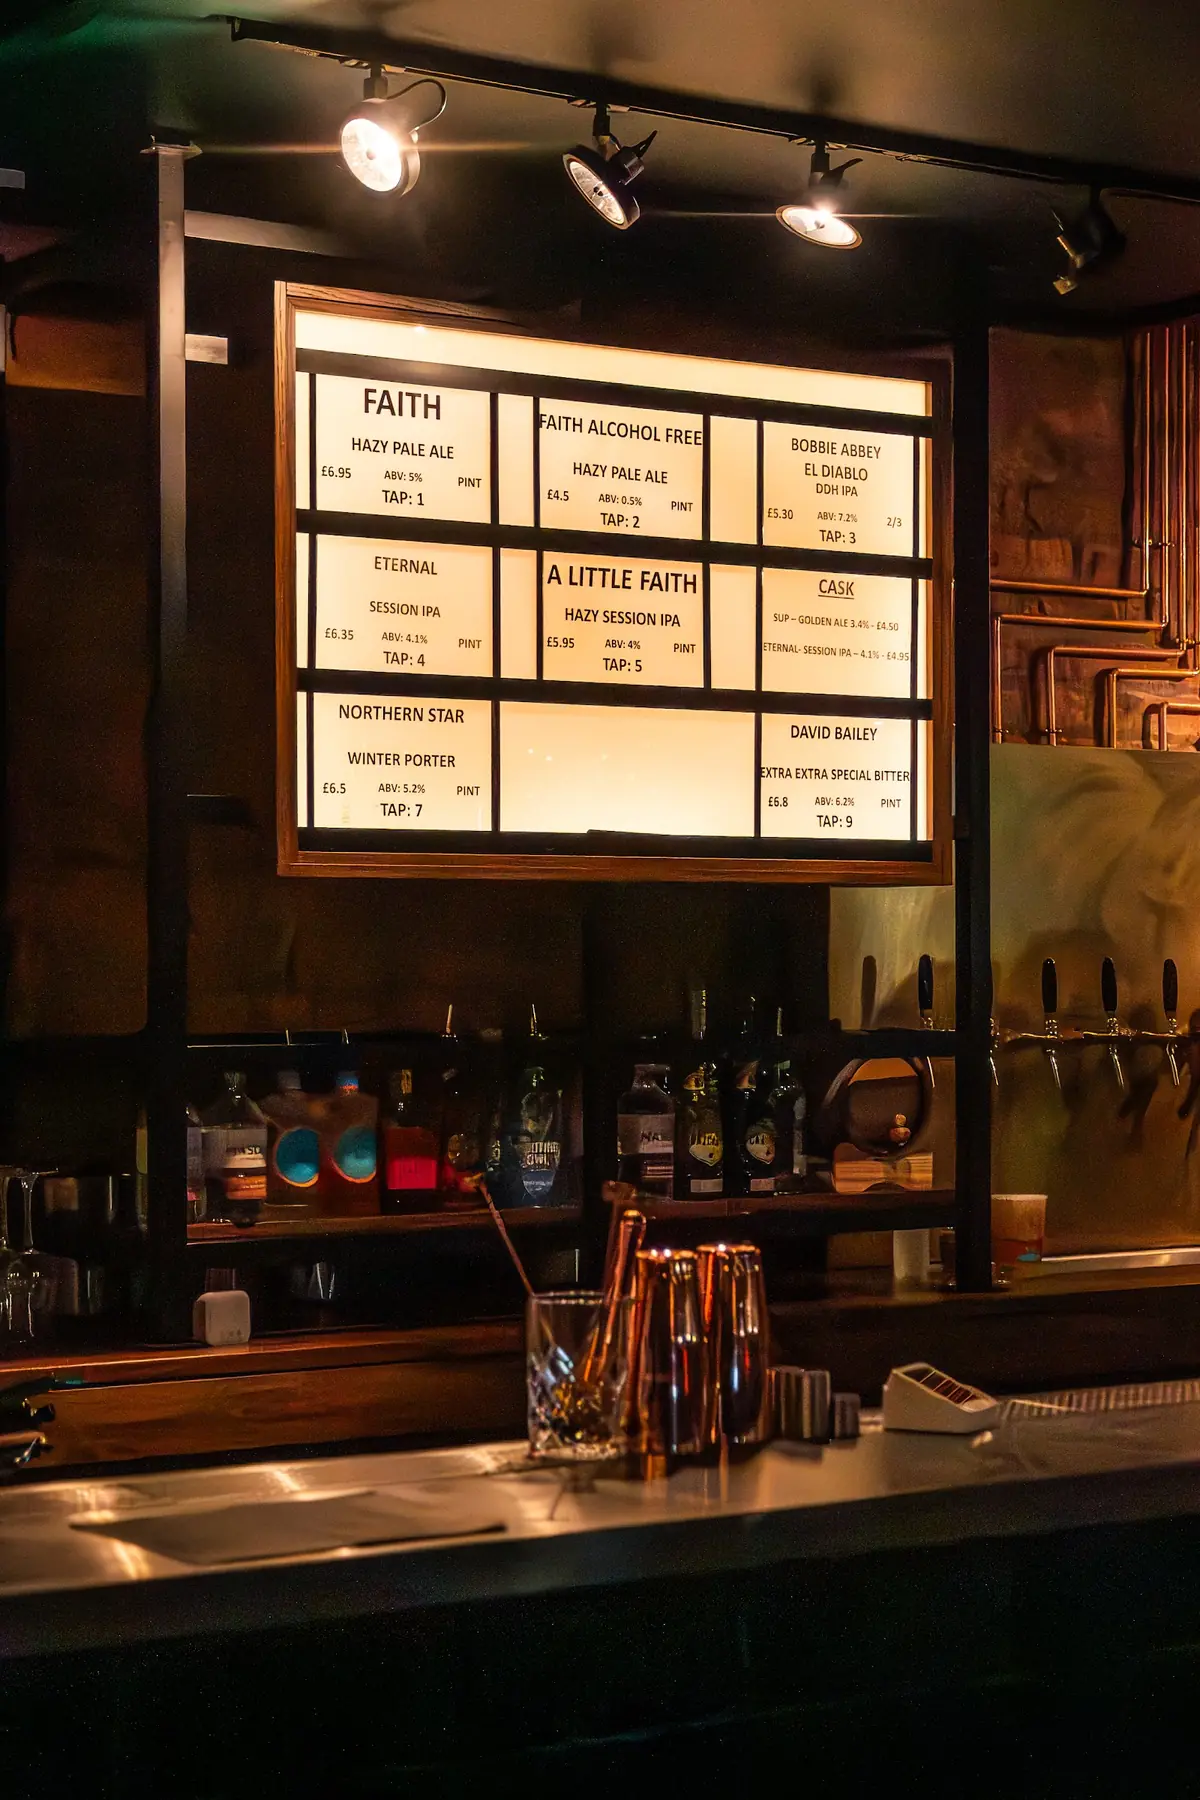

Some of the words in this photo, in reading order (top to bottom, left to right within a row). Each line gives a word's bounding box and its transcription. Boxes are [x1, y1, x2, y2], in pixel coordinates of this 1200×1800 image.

[364, 388, 442, 421] FAITH
[539, 413, 583, 433] FAITH
[588, 420, 661, 442] ALCOHOL
[665, 428, 703, 446] FREE
[352, 438, 389, 454] HAZY
[393, 442, 426, 457] PALE
[430, 445, 454, 460] ALE
[791, 438, 837, 455] BOBBIE
[841, 443, 881, 459] ABBEY
[321, 466, 352, 480] £6.95
[384, 470, 408, 482] ABV:
[409, 472, 423, 483] 5%
[458, 477, 483, 489] PINT
[573, 462, 607, 478] HAZY
[612, 466, 641, 482] PALE
[645, 470, 668, 485] ALE
[804, 463, 818, 477] EL
[822, 464, 868, 481] DIABLO
[382, 490, 413, 505] TAP:
[417, 493, 425, 507] 1
[816, 483, 839, 495] DDH
[842, 485, 858, 497] IPA
[547, 489, 570, 502] £4.5
[598, 493, 619, 504] ABV:
[621, 495, 642, 507] 0.5%
[671, 501, 694, 512] PINT
[600, 512, 629, 527] TAP:
[632, 516, 640, 529] 2
[767, 508, 794, 520] £5.30
[817, 511, 837, 521] ABV:
[838, 513, 858, 523] 7.2%
[887, 517, 902, 528] 2/3
[819, 530, 846, 543] TAP:
[849, 532, 856, 544] 3
[375, 556, 438, 576] ETERNAL
[547, 564, 563, 585] A
[569, 566, 633, 590] LITTLE
[640, 570, 697, 594] FAITH
[819, 579, 855, 597] CASK
[369, 601, 419, 617] SESSION
[422, 606, 441, 618] IPA
[565, 608, 599, 622] HAZY
[602, 610, 656, 626] SESSION
[660, 614, 681, 628] IPA
[773, 613, 790, 623] SUP
[798, 615, 832, 627] GOLDEN
[834, 618, 849, 628] ALE
[850, 620, 870, 630] 3.4%
[876, 622, 899, 632] £4.50
[324, 628, 354, 641] £6.35
[381, 631, 404, 642] ABV:
[405, 634, 428, 644] 4.1%
[458, 638, 482, 649] PINT
[547, 636, 575, 649] £5.95
[604, 639, 626, 649] ABV:
[627, 640, 641, 650] 4%
[673, 643, 696, 654] PINT
[383, 651, 413, 666] TAP:
[417, 654, 426, 667] 4
[803, 645, 837, 657] SESSION
[839, 648, 852, 658] IPA
[860, 650, 880, 659] 4.1%
[887, 652, 910, 662] £4.95
[603, 658, 631, 672] TAP:
[635, 660, 643, 672] 5
[339, 705, 424, 722] NORTHERN
[428, 708, 465, 724] STAR
[791, 725, 831, 740] DAVID
[835, 726, 878, 741] BAILEY
[347, 751, 401, 766] WINTER
[405, 754, 456, 768] PORTER
[760, 767, 793, 779] EXTRA
[795, 768, 829, 780] EXTRA
[831, 769, 871, 781] SPECIAL
[874, 770, 911, 782] BITTER
[322, 782, 347, 794] £6.5
[378, 783, 401, 793] ABV:
[403, 784, 426, 794] 5.2%
[456, 786, 481, 796] PINT
[380, 803, 411, 817] TAP:
[415, 804, 423, 818] 7
[768, 796, 789, 808] £6.8
[815, 797, 834, 806] ABV:
[835, 797, 855, 807] 6.2%
[880, 799, 902, 808] PINT
[816, 815, 843, 828] TAP:
[846, 816, 853, 828] 9
